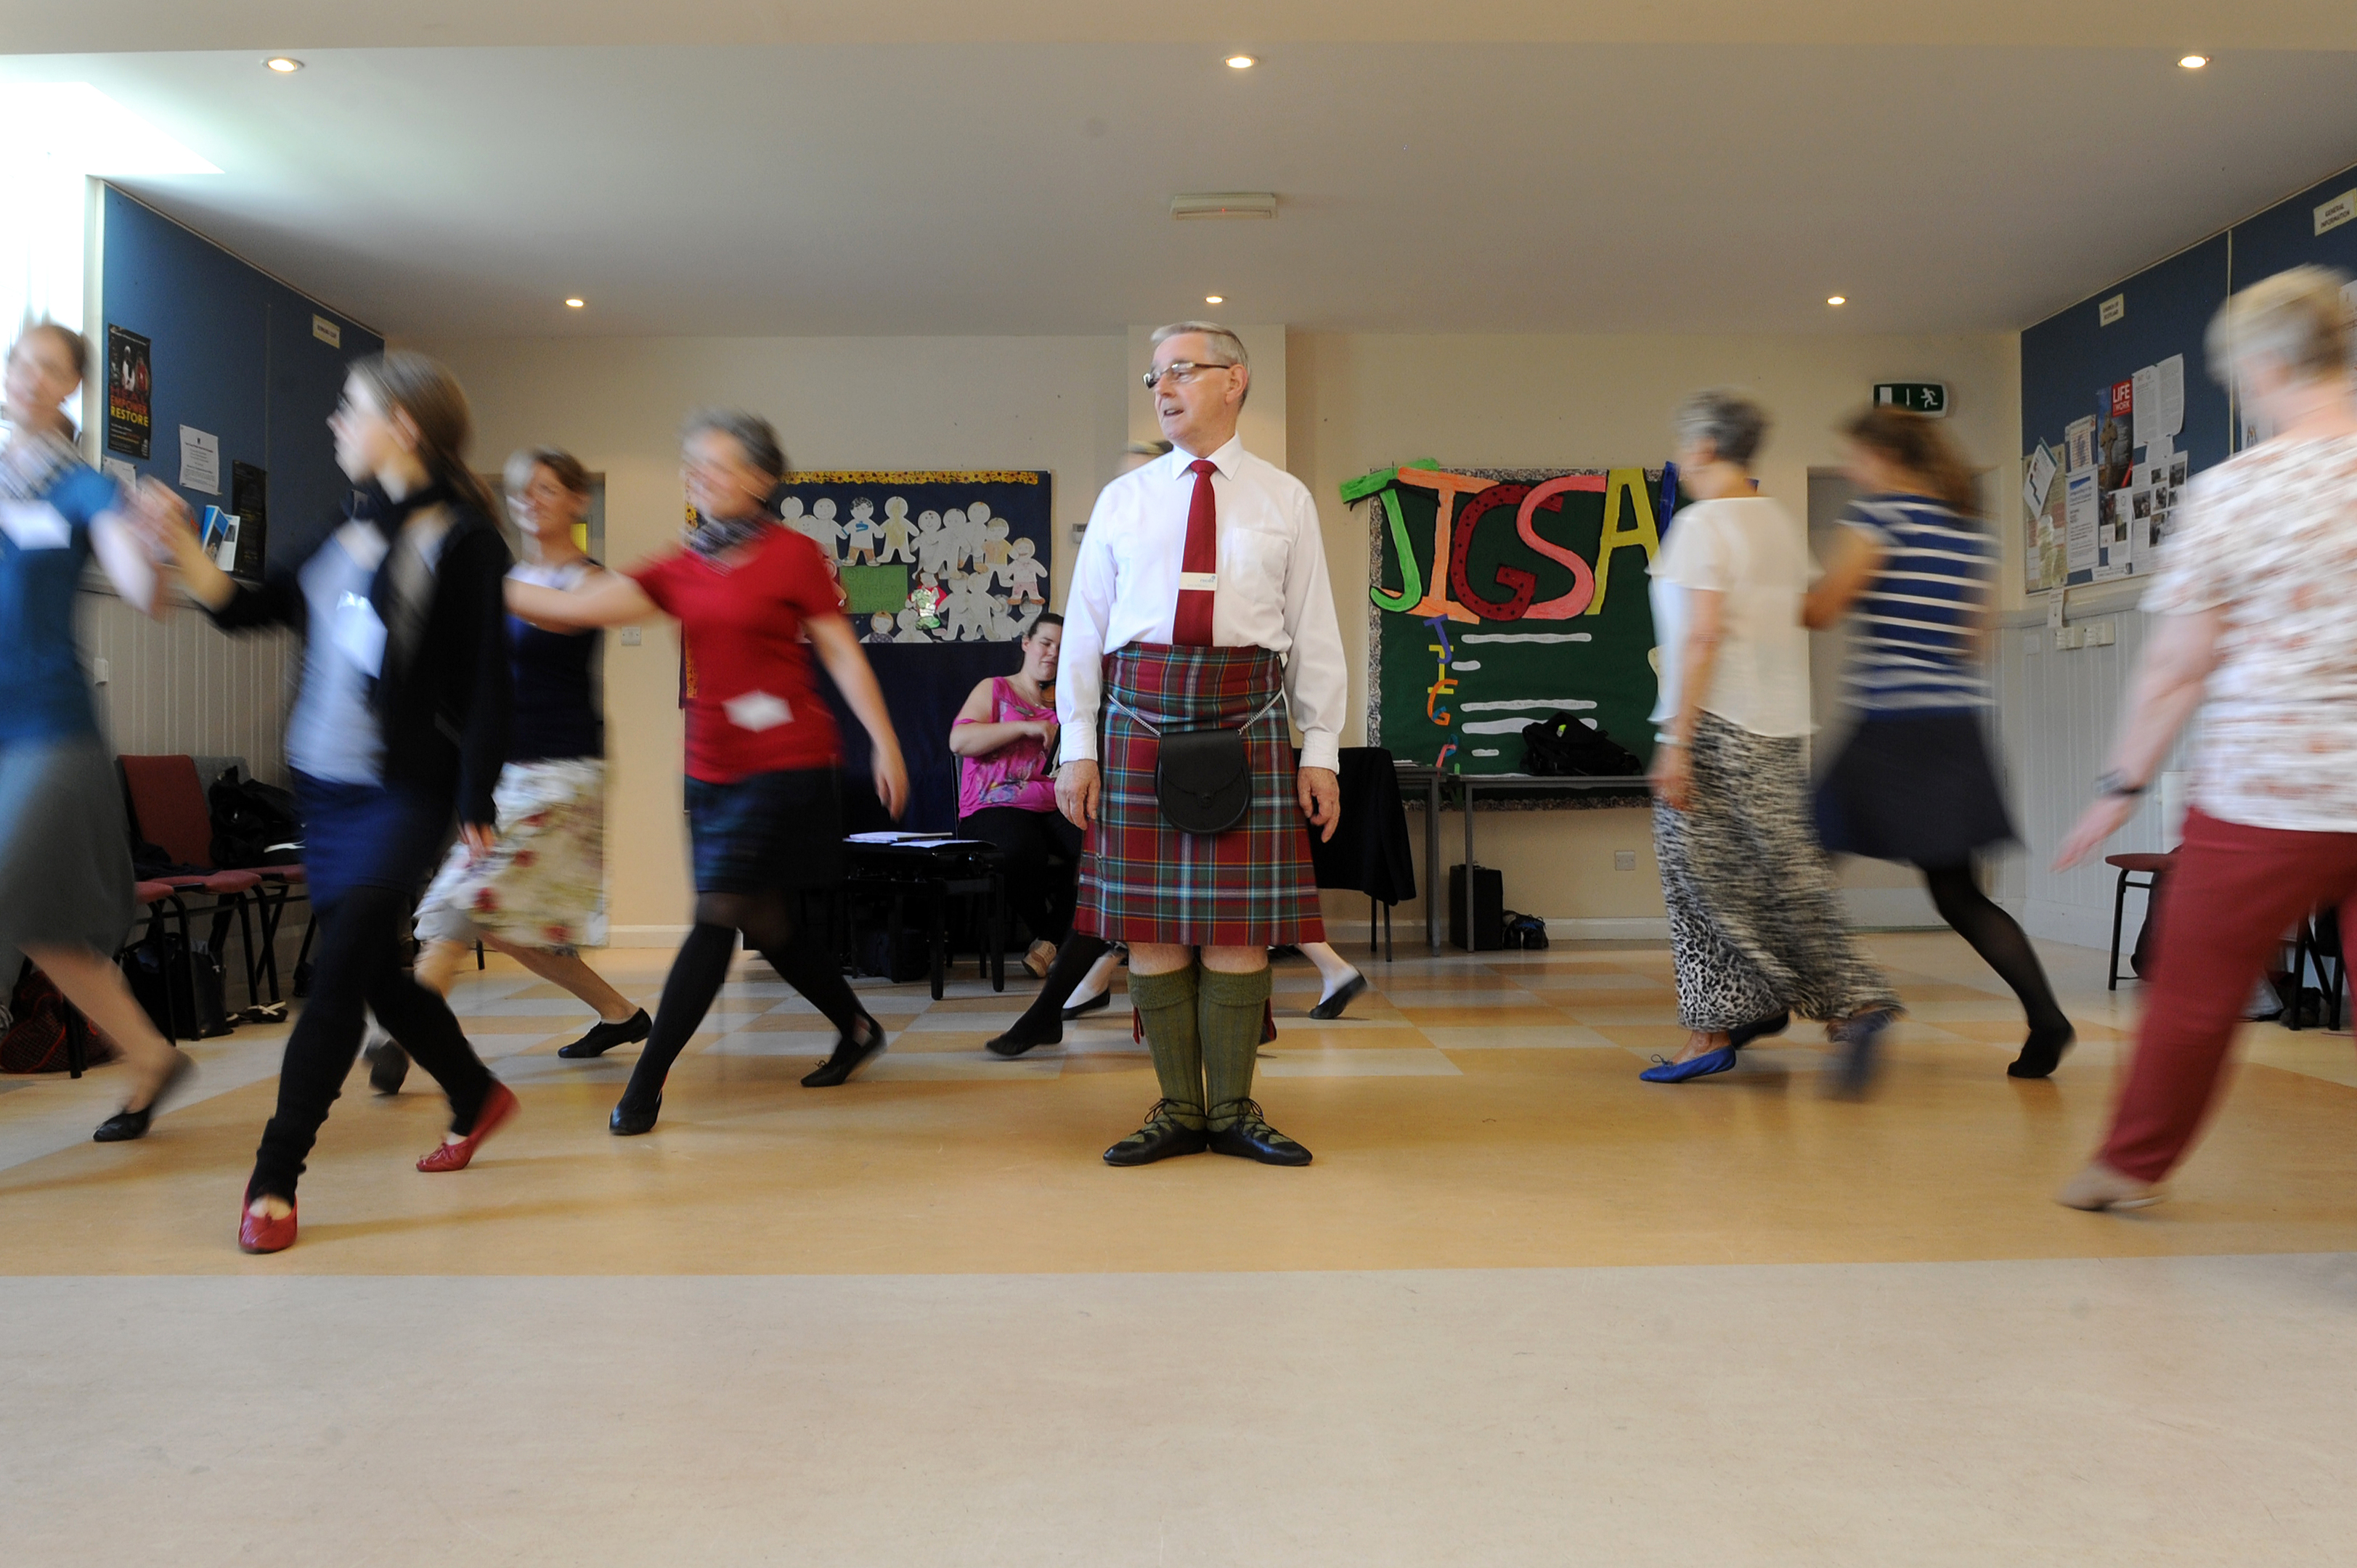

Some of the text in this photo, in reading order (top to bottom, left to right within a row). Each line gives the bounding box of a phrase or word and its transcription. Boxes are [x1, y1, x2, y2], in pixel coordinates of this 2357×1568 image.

[2320, 210, 2350, 229] INFORMATION
[2113, 384, 2130, 403] LIFE
[110, 395, 148, 415] EMPOWER
[110, 405, 149, 427] RESTORE
